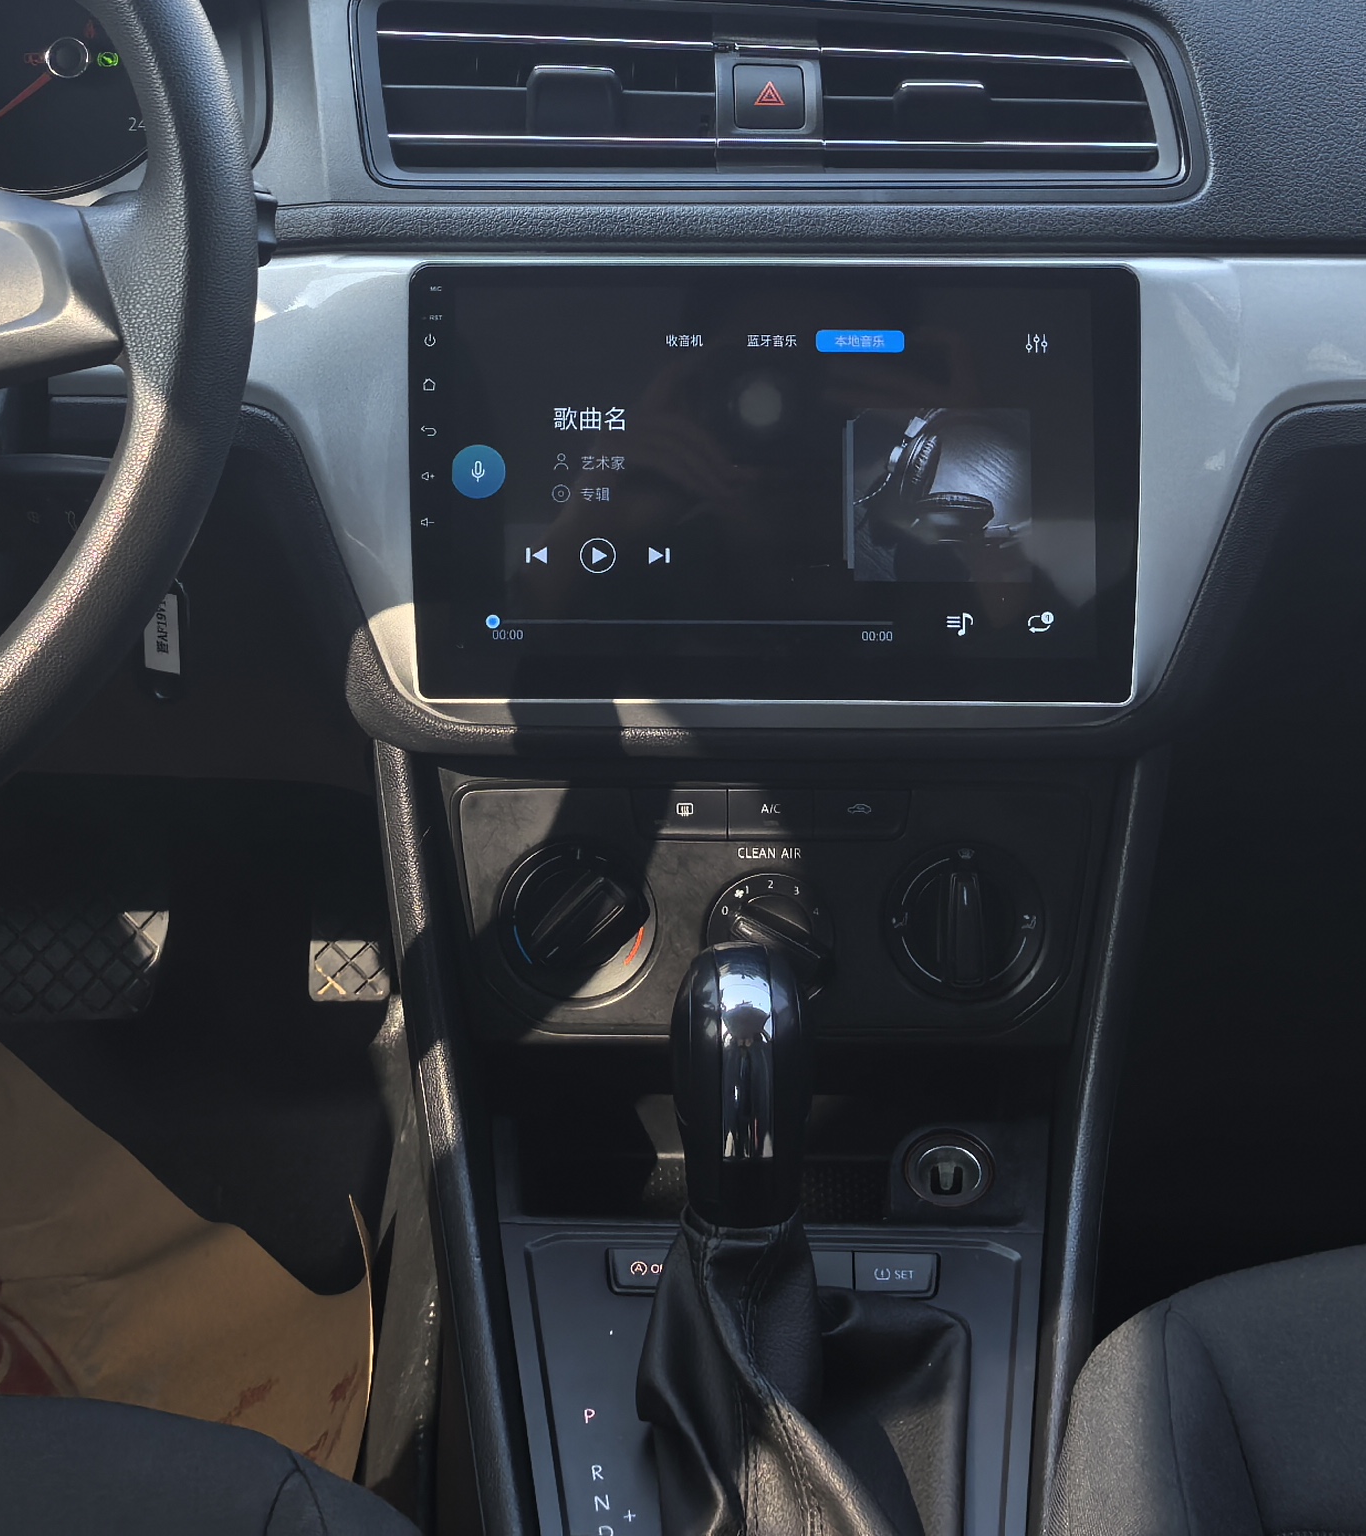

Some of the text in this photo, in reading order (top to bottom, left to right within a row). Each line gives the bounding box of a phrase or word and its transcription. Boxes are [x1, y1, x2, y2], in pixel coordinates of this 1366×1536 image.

[665, 333, 704, 349] 收音机
[747, 333, 798, 349] 蓝牙音乐
[834, 333, 886, 349] 本地音乐
[552, 406, 627, 433] 歌曲名
[580, 454, 625, 472] 艺术家
[580, 486, 610, 503] 专辑
[492, 629, 524, 641] 00:00
[861, 630, 893, 642] 00:00
[760, 803, 781, 814] A/C
[737, 847, 802, 859] CLEAN AIR
[767, 880, 774, 889] 2
[894, 1269, 914, 1280] SET
[584, 1408, 596, 1424] P
[591, 1465, 604, 1481] R
[594, 1494, 610, 1512] N
